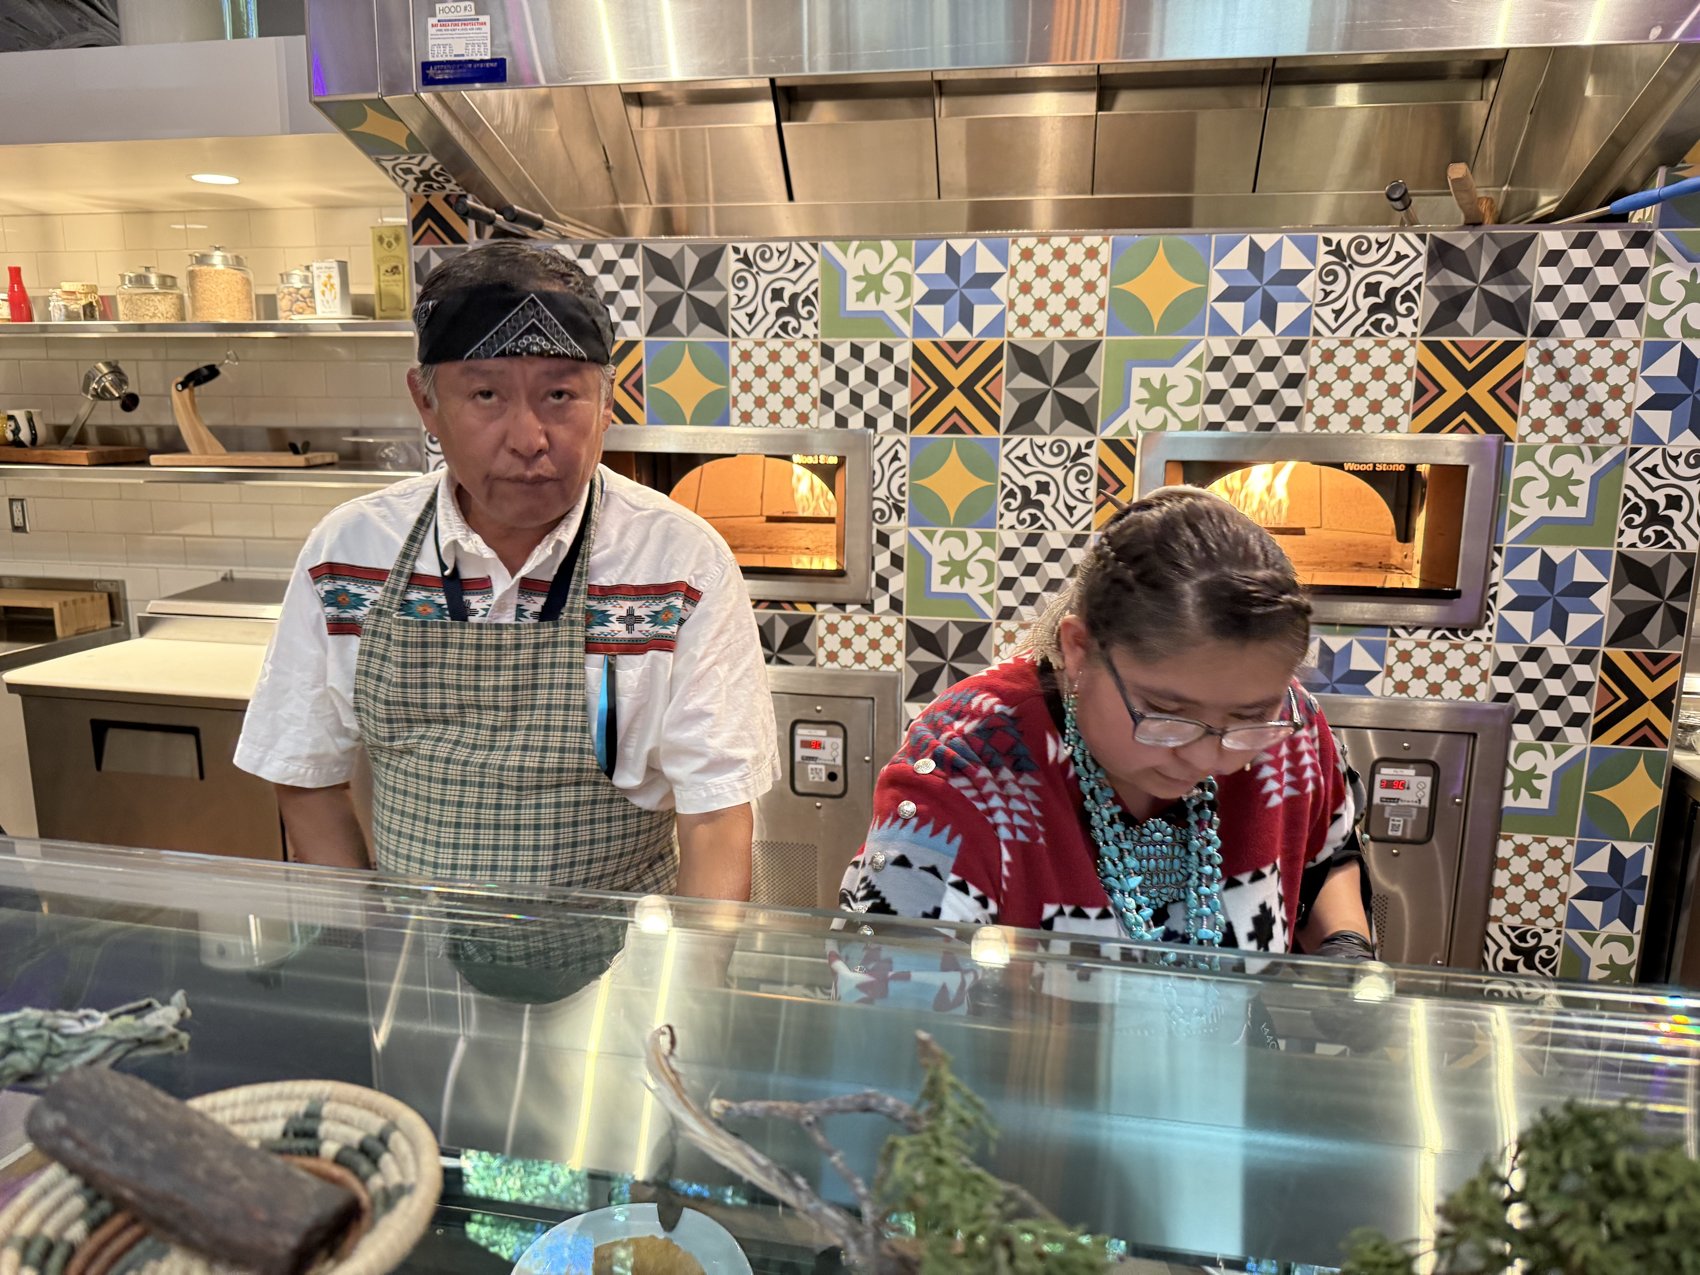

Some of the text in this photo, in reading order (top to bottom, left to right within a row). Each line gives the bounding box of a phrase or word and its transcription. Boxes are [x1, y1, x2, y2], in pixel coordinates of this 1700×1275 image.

[438, 4, 473, 15] HOOD #3
[792, 454, 819, 464] Wood
[1343, 462, 1374, 471] Wood
[1375, 462, 1406, 472] Stone
